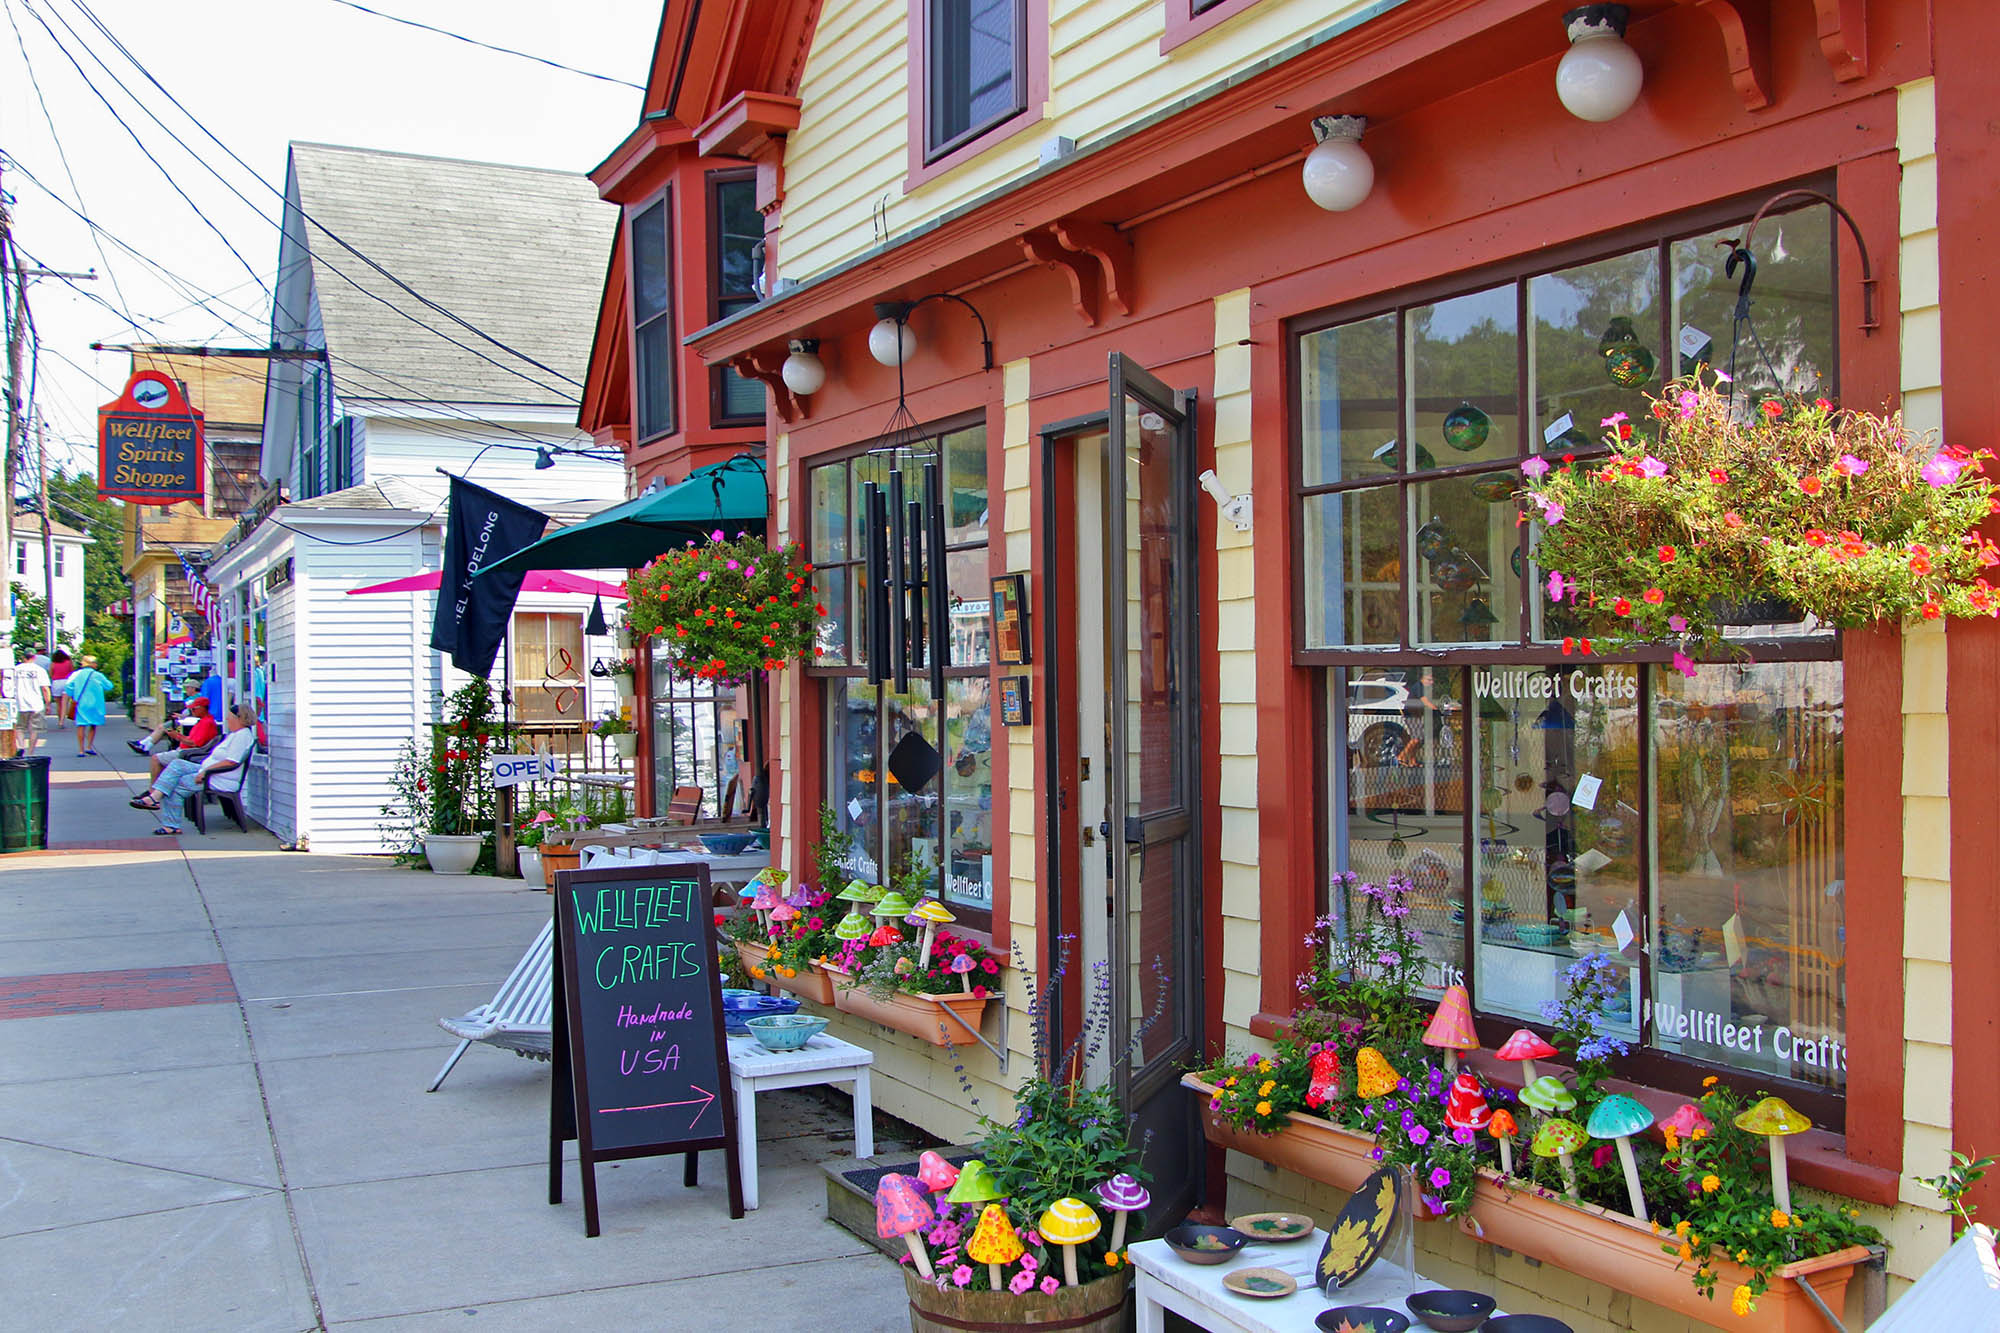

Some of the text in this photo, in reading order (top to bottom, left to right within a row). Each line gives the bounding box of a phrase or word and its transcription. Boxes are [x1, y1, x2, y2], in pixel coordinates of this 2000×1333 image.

[110, 422, 192, 443] Wellfleet
[118, 441, 185, 464] Spirits
[113, 464, 186, 488] Shoppe
[1473, 669, 1637, 700] Wellfleet Crafts
[495, 758, 556, 777] OPEN
[945, 872, 982, 898] Wellfleet
[572, 880, 699, 935] WELLFLEET
[595, 942, 701, 990] CRAFTS
[1654, 1002, 1763, 1054] Wellfleet
[620, 1043, 681, 1076] USA
